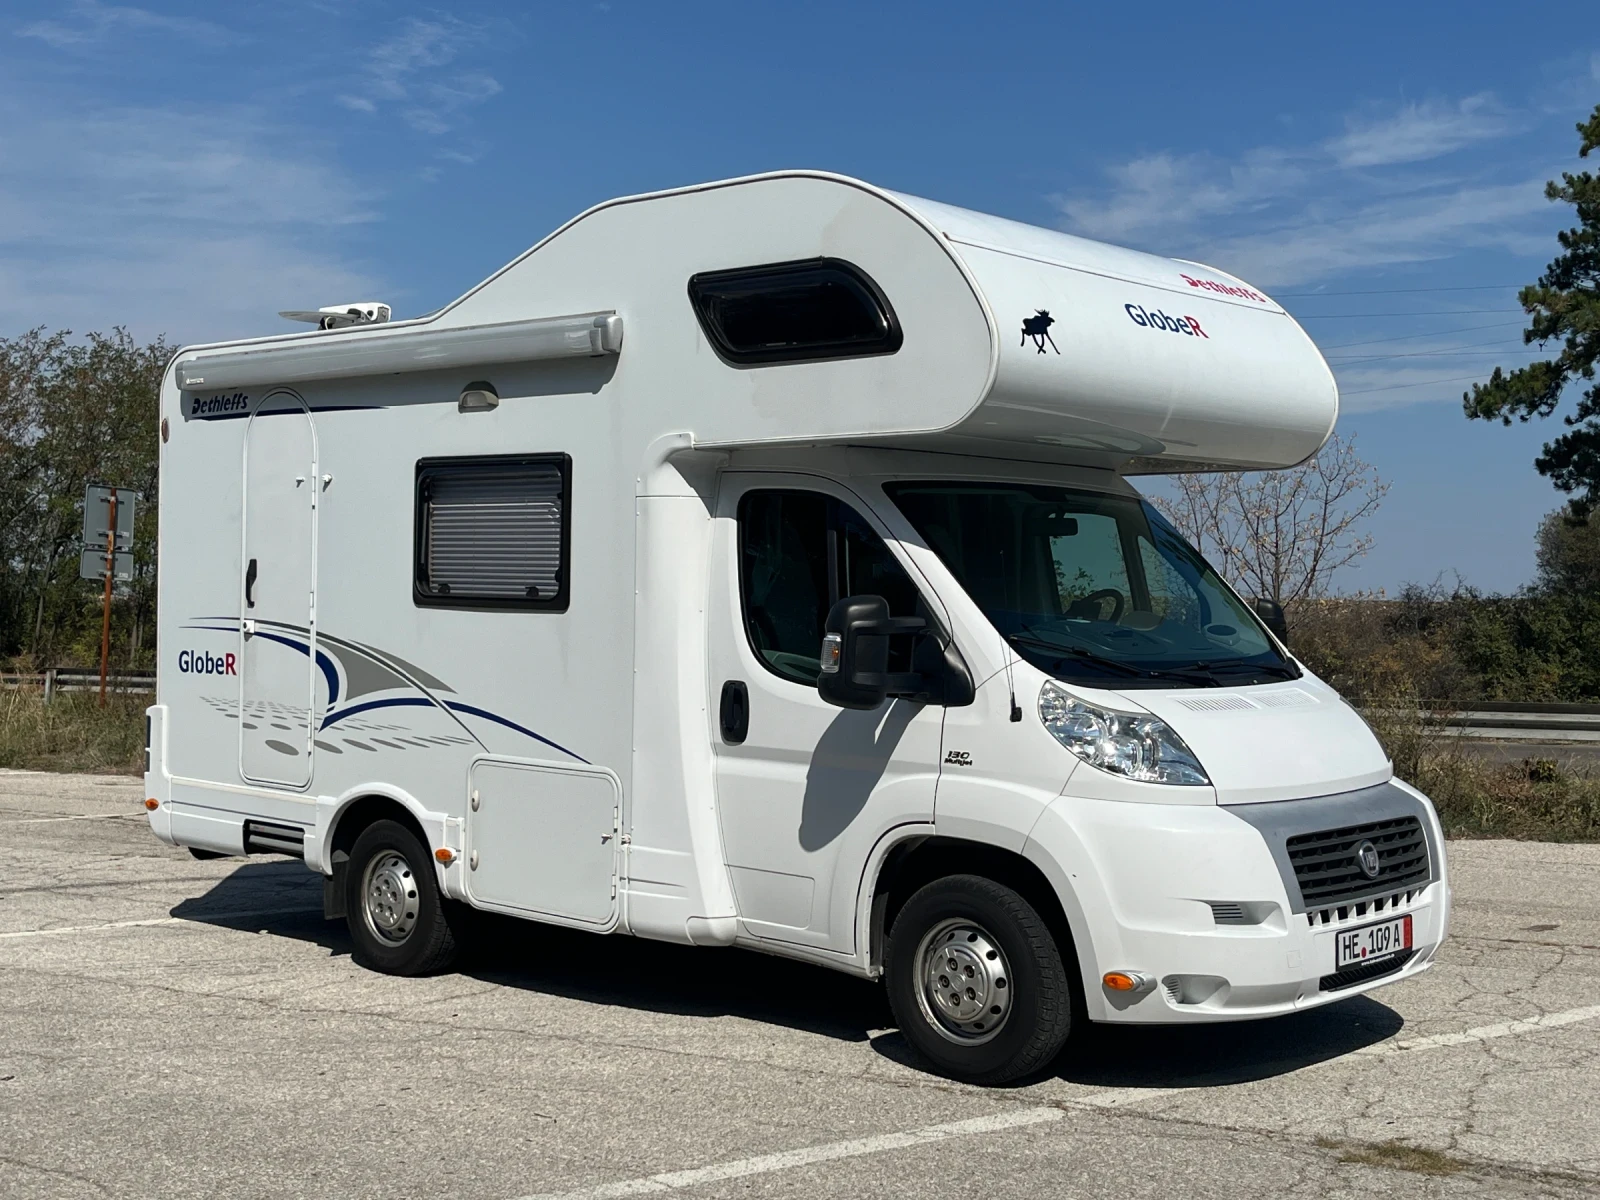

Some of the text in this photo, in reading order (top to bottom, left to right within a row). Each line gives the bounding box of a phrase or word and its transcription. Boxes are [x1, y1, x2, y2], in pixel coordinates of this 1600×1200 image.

[1124, 303, 1209, 339] GlobeR
[191, 392, 249, 415] Dethleffs
[178, 649, 237, 676] GlobeR
[947, 750, 970, 760] 130
[1343, 933, 1361, 961] HE
[1368, 925, 1391, 955] 109
[1393, 923, 1401, 948] A
